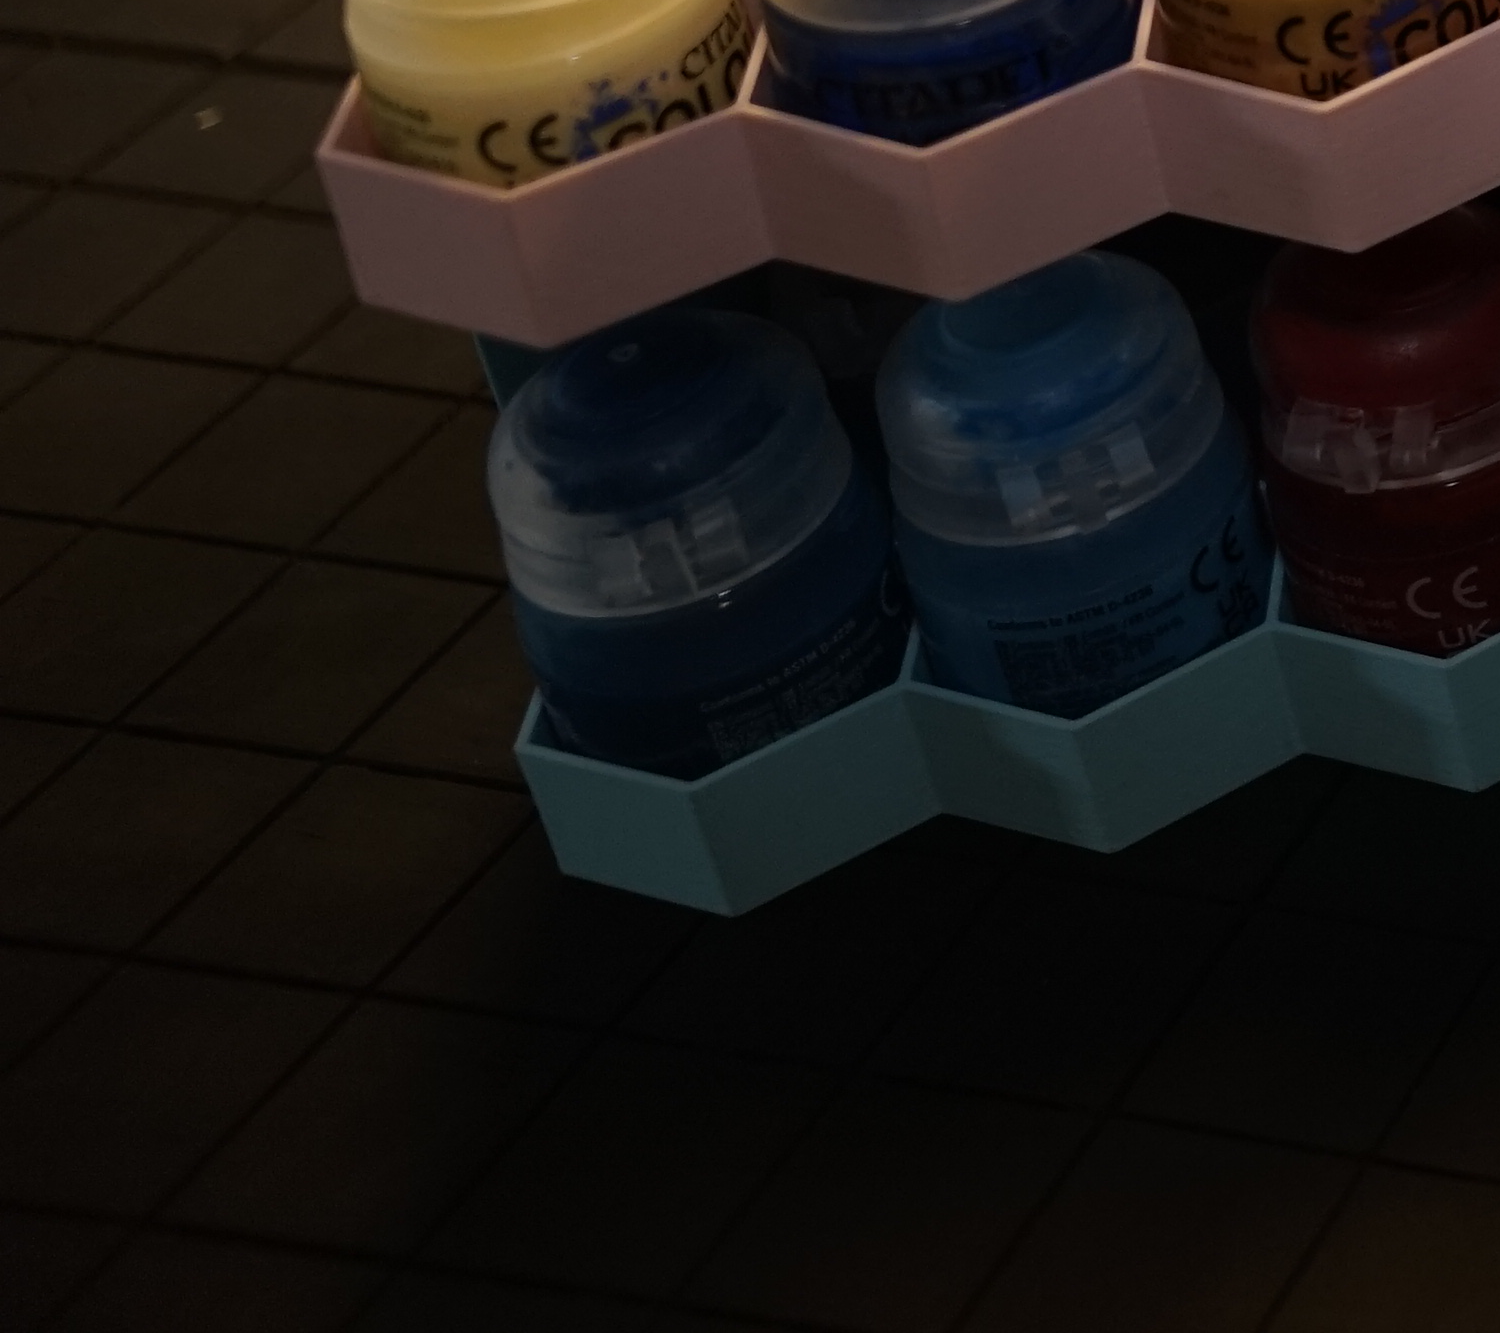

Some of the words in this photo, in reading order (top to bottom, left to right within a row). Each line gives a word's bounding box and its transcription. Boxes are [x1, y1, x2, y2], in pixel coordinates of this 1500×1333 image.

[1276, 9, 1358, 65] CE
[1300, 69, 1356, 97] UK
[479, 113, 571, 173] CE
[1190, 515, 1245, 594] CE
[1067, 605, 1105, 624] ASTM
[1405, 565, 1490, 620] CE
[1437, 618, 1492, 648] UK
